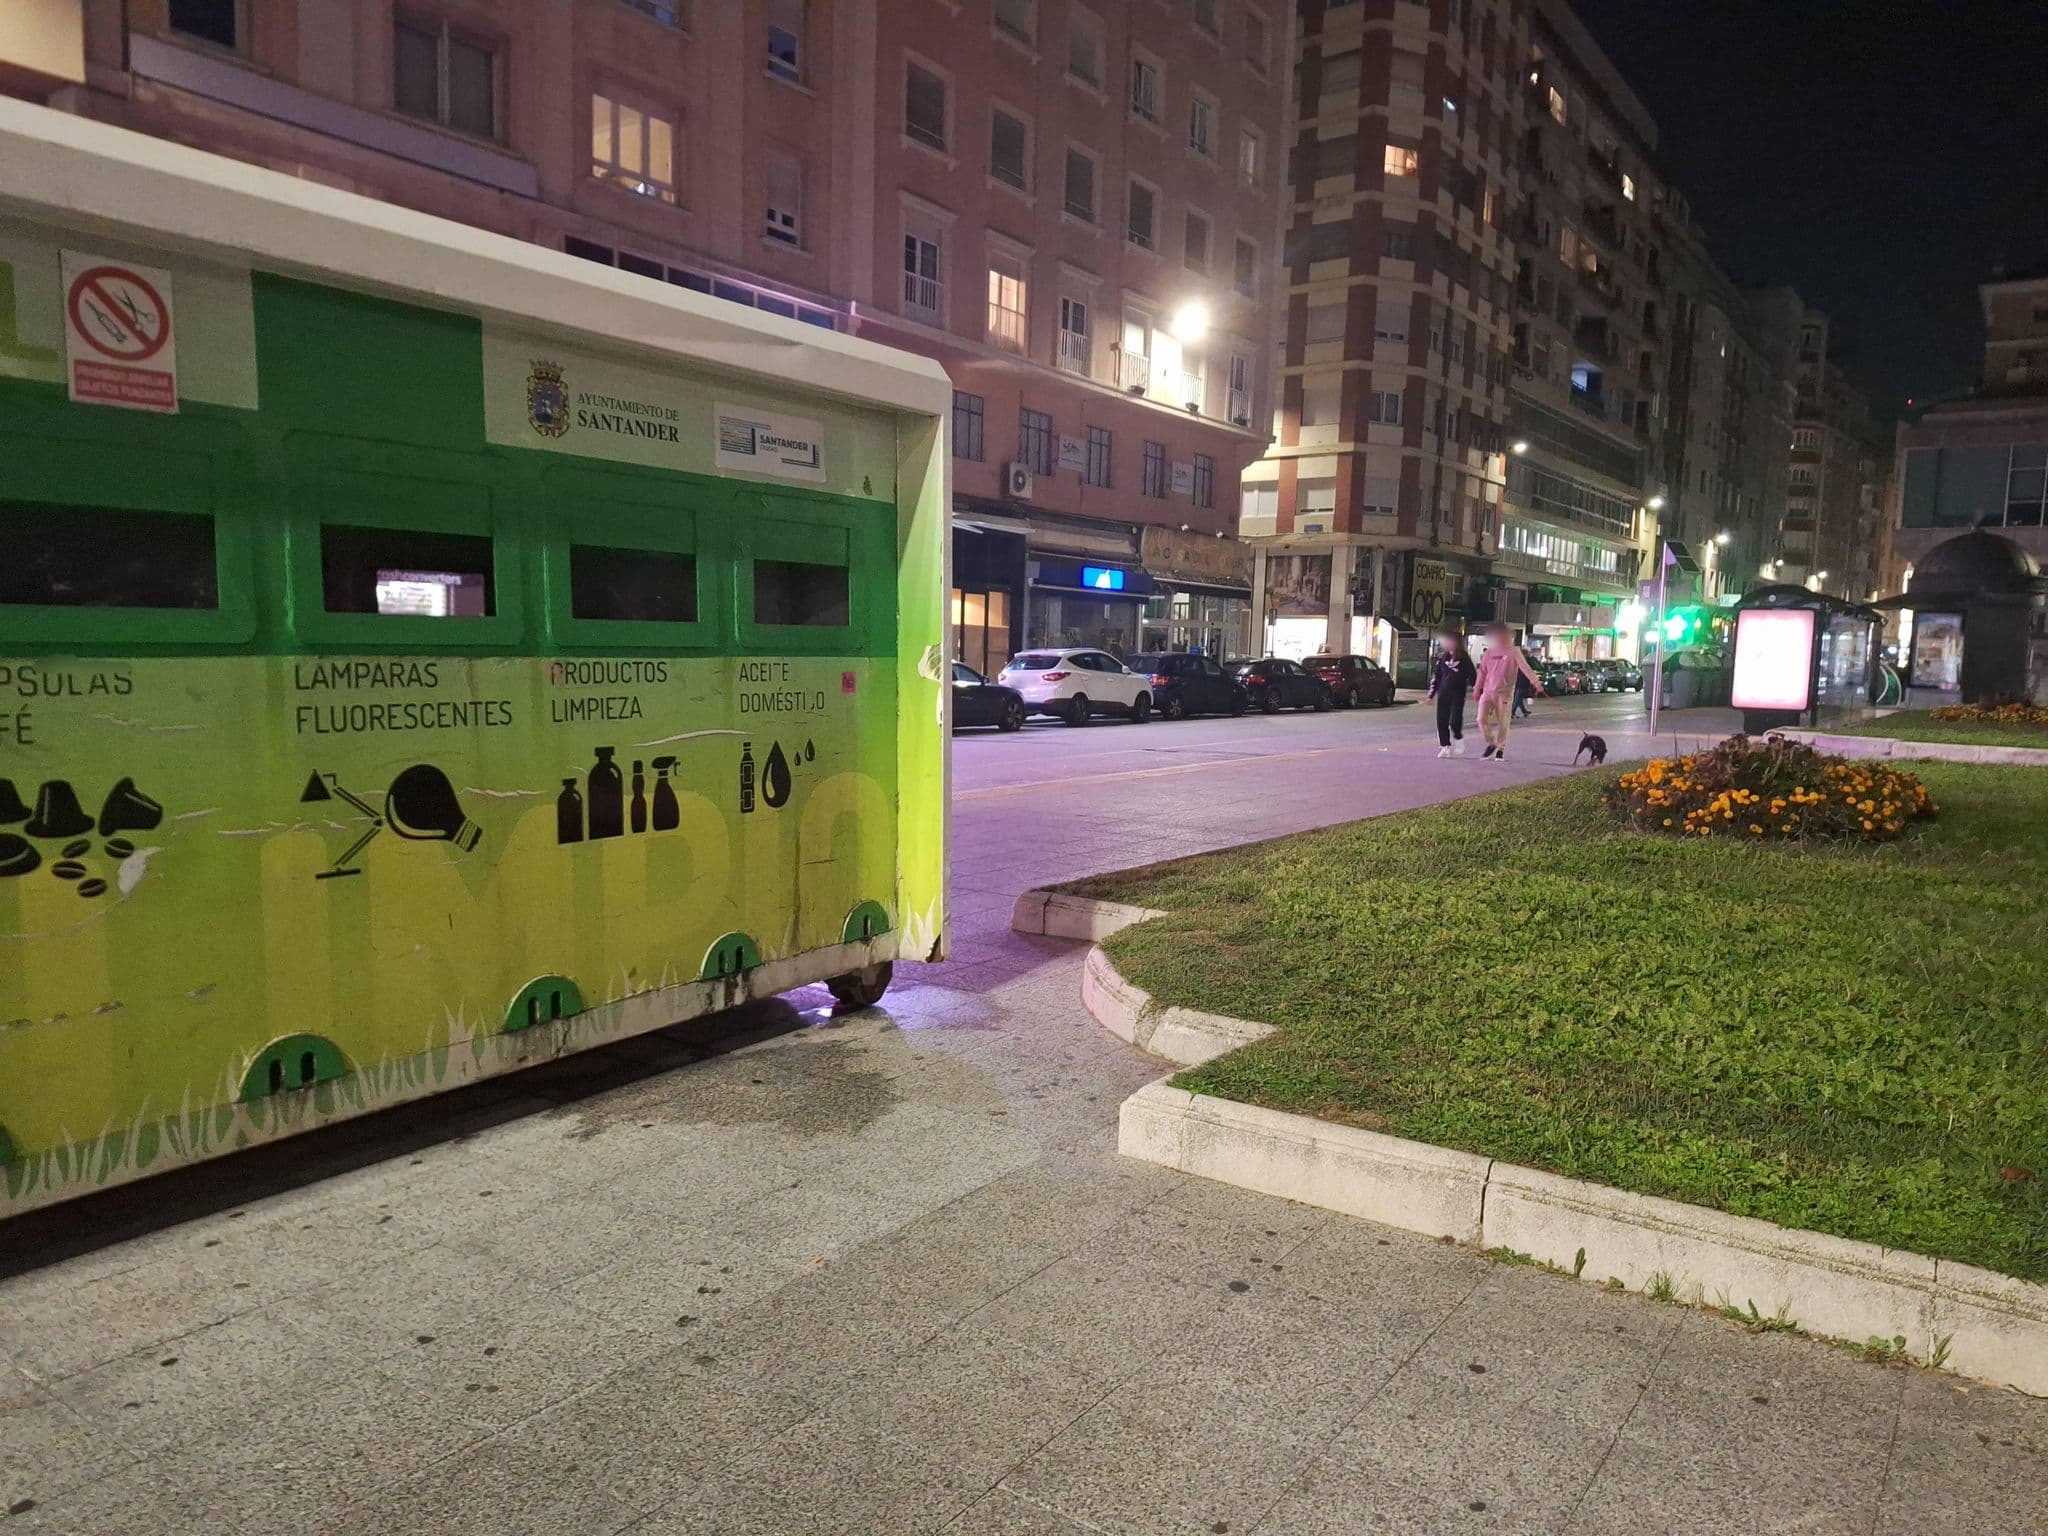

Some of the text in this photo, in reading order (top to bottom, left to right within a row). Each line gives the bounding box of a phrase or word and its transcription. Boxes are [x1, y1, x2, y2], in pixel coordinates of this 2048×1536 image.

[578, 392, 680, 421] AYUNTAMIENTO DE
[577, 409, 680, 443] SANTANDER
[760, 434, 809, 452] SANTANDER
[1416, 562, 1446, 581] COMPRO
[1413, 588, 1444, 624] ORO
[551, 661, 668, 685] PRODUCTOS
[552, 696, 643, 723] LIMPIEZA
[740, 686, 825, 713] DOMÉSTIO
[296, 701, 513, 734] FLUORESCENTES
